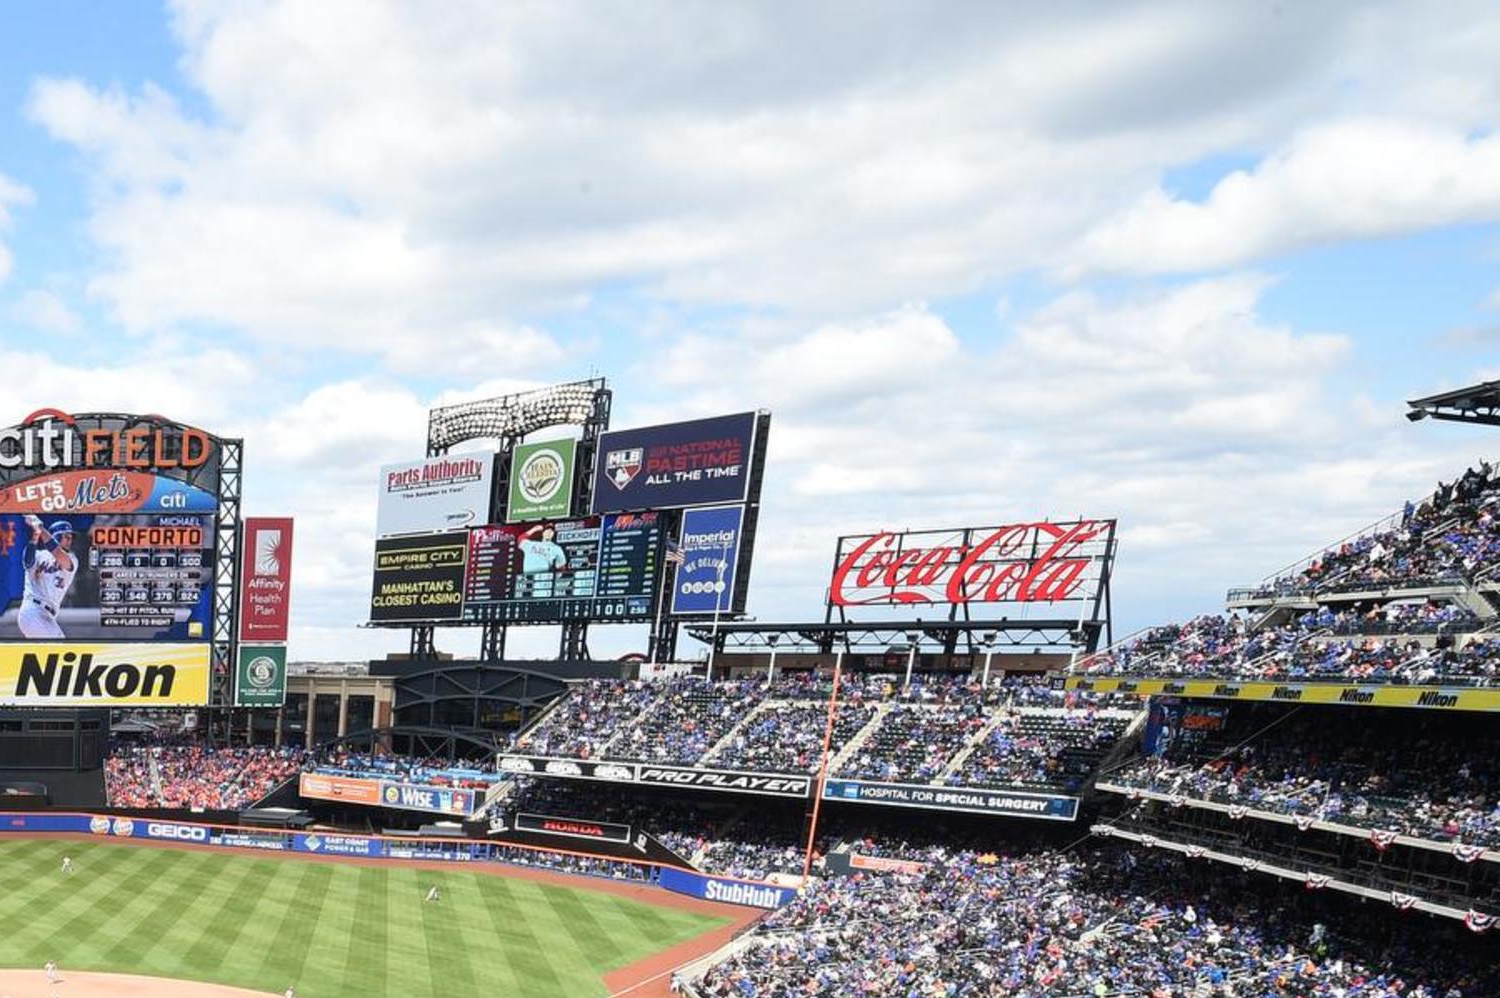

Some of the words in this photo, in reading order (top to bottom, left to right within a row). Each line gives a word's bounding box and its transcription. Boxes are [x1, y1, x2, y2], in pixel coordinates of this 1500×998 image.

[86, 428, 210, 467] FIELD
[670, 438, 741, 455] NATIONAL
[609, 450, 641, 466] MLB
[647, 450, 741, 473] PASTIME
[388, 467, 420, 486] Parts
[422, 459, 482, 481] Authority
[645, 473, 671, 486] ALL
[674, 470, 702, 482] THE
[705, 465, 742, 478] TIME
[15, 480, 63, 503] LET'S
[41, 494, 66, 511] GO
[66, 473, 130, 511] Mets
[160, 517, 200, 526] MICHAEL
[94, 529, 201, 544] CONFORTO
[685, 530, 734, 543] Imperial
[380, 553, 428, 565] EMPIRE
[430, 551, 460, 561] CITY
[248, 579, 285, 591] Affinity
[381, 580, 454, 594] MANHATTAN'S
[250, 594, 281, 603] Health
[372, 594, 419, 606] CLOSEST
[420, 592, 461, 604] CASINO
[255, 605, 275, 615] Plan
[605, 604, 613, 615] 0
[615, 603, 624, 614] 0
[15, 652, 176, 697] Nikon
[1213, 685, 1239, 697] Nikon
[1271, 686, 1302, 699] Nikon
[1339, 688, 1374, 703] Nikon
[1417, 691, 1458, 707] Nikon
[640, 769, 694, 783] PRO
[695, 774, 806, 793] PLAYER
[401, 788, 434, 807] WISE
[860, 787, 910, 801] HOSPITAL
[912, 791, 933, 801] FOR
[935, 793, 986, 807] SPECIAL
[988, 797, 1048, 811] SURGERY
[148, 824, 206, 840] GEICO
[543, 821, 604, 836] HONDA
[325, 837, 344, 845] EAST
[345, 838, 369, 846] COAST
[705, 880, 782, 908] StubHub!
